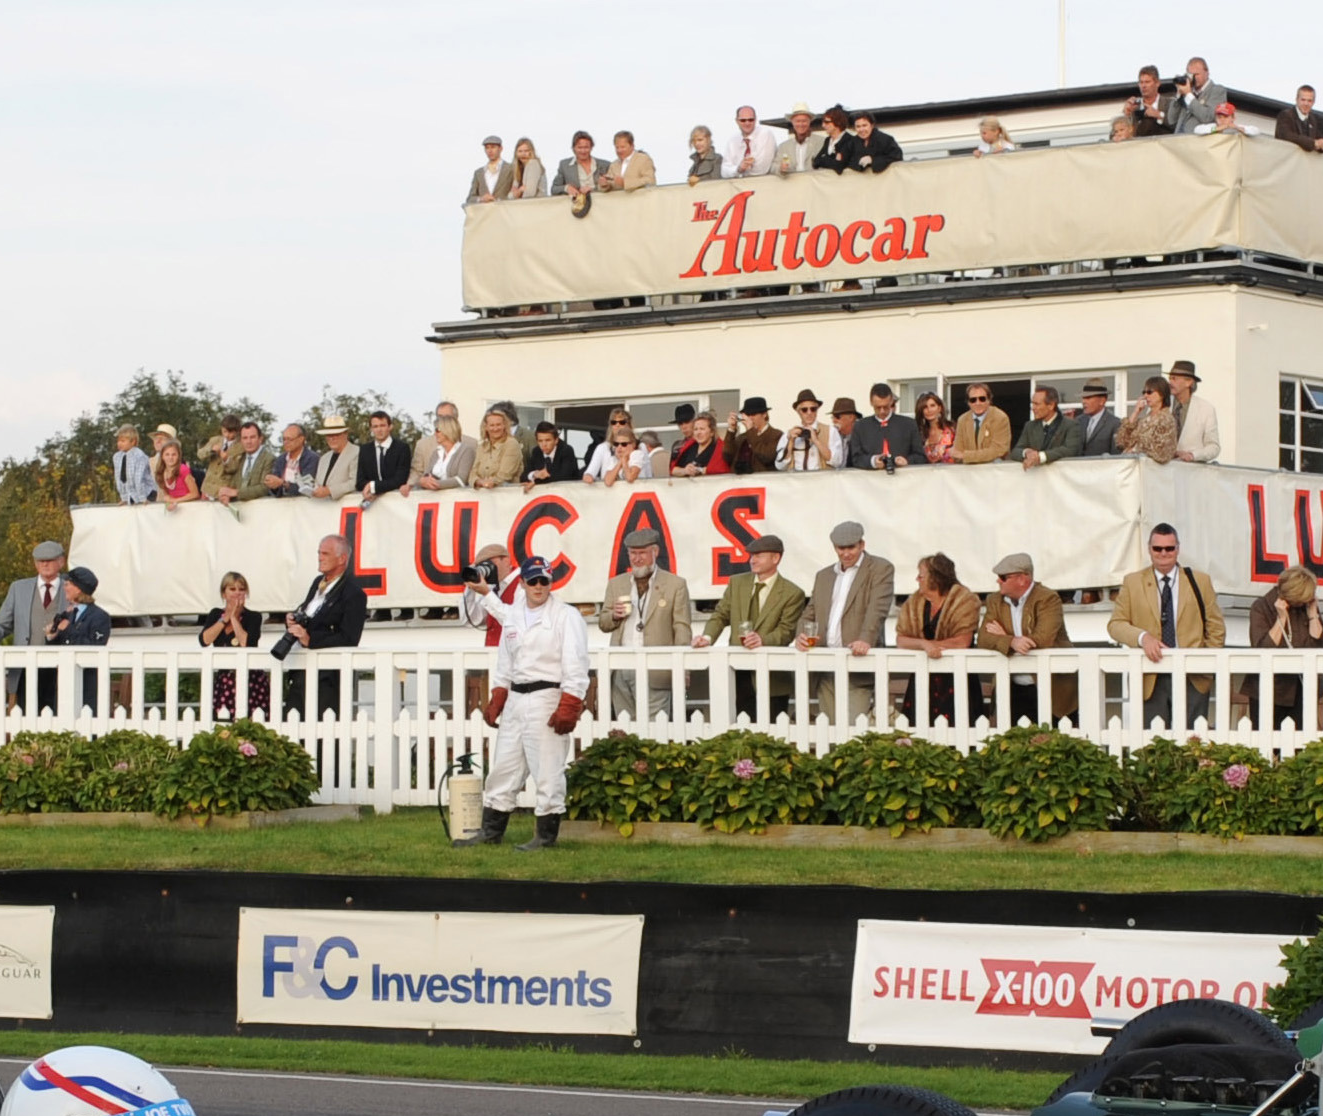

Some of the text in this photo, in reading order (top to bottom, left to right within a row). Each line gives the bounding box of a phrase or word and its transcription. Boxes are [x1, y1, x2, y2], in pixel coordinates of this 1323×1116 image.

[679, 190, 945, 279] Autocar
[691, 201, 718, 222] The
[340, 487, 766, 596] LUCAS
[262, 934, 612, 1008] F&C Investments
[873, 966, 976, 1002] SHELL
[992, 969, 1076, 1008] X-100
[1095, 975, 1220, 1009] MOTOR
